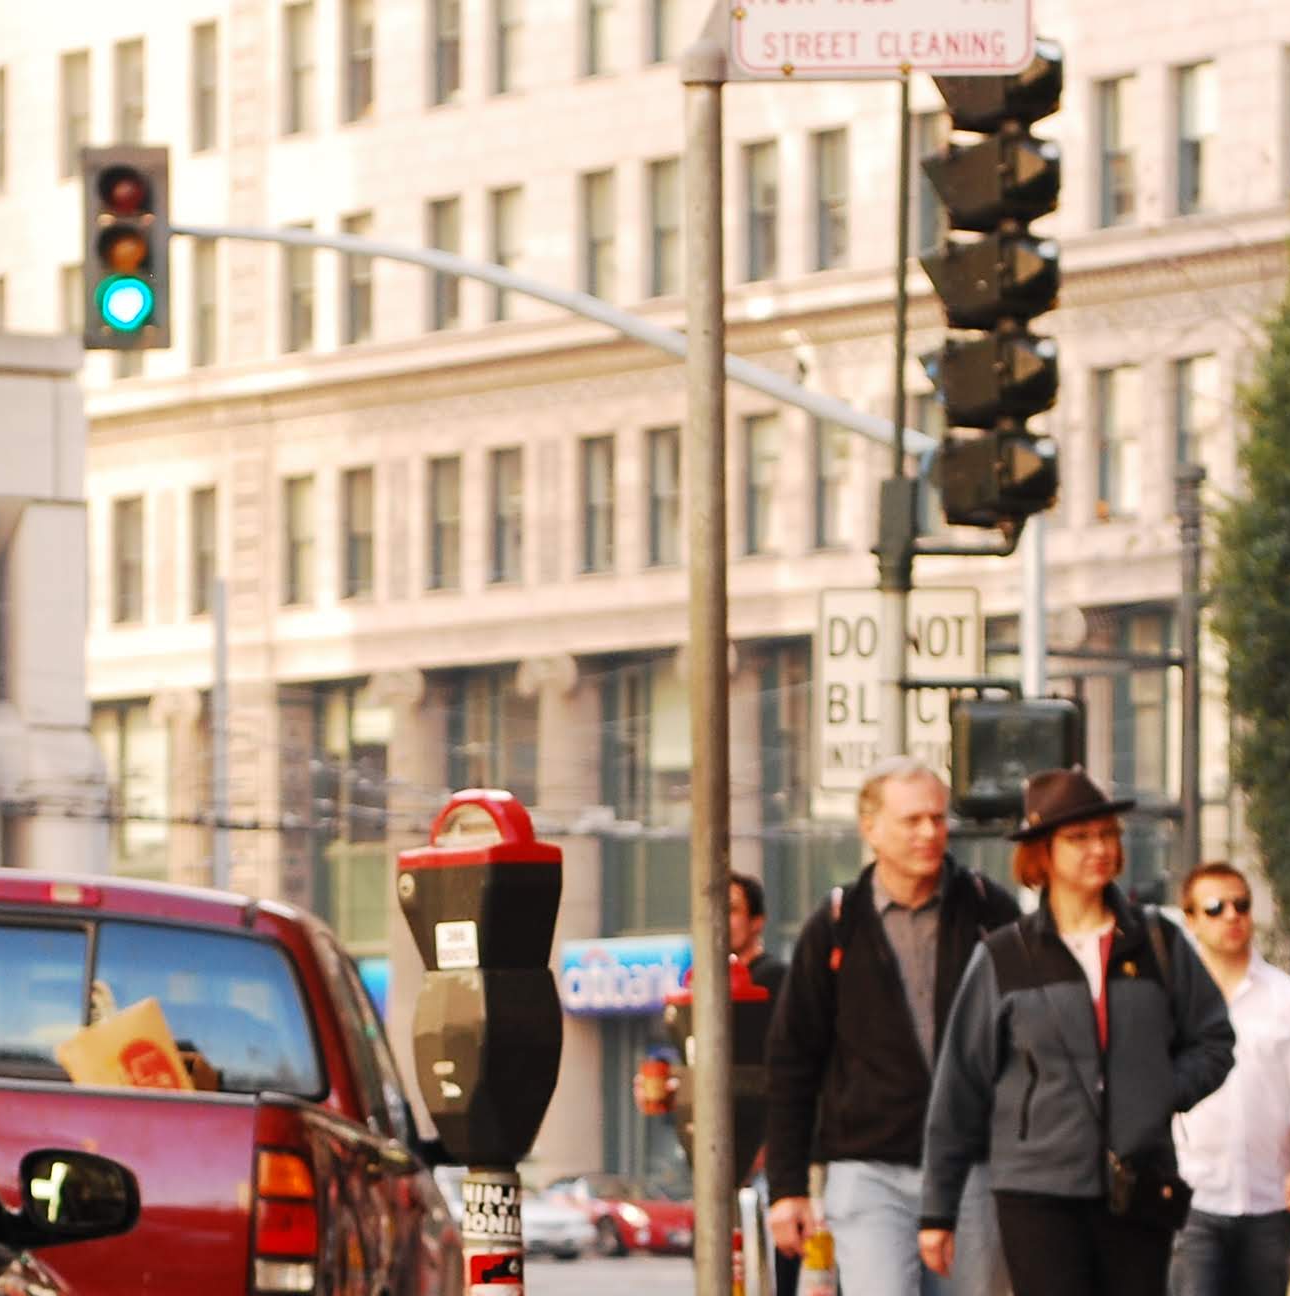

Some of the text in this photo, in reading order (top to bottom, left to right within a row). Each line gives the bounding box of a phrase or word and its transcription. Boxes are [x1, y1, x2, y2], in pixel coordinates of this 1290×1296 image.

[763, 28, 1006, 59] STREET CLEANING
[827, 615, 878, 658] DO
